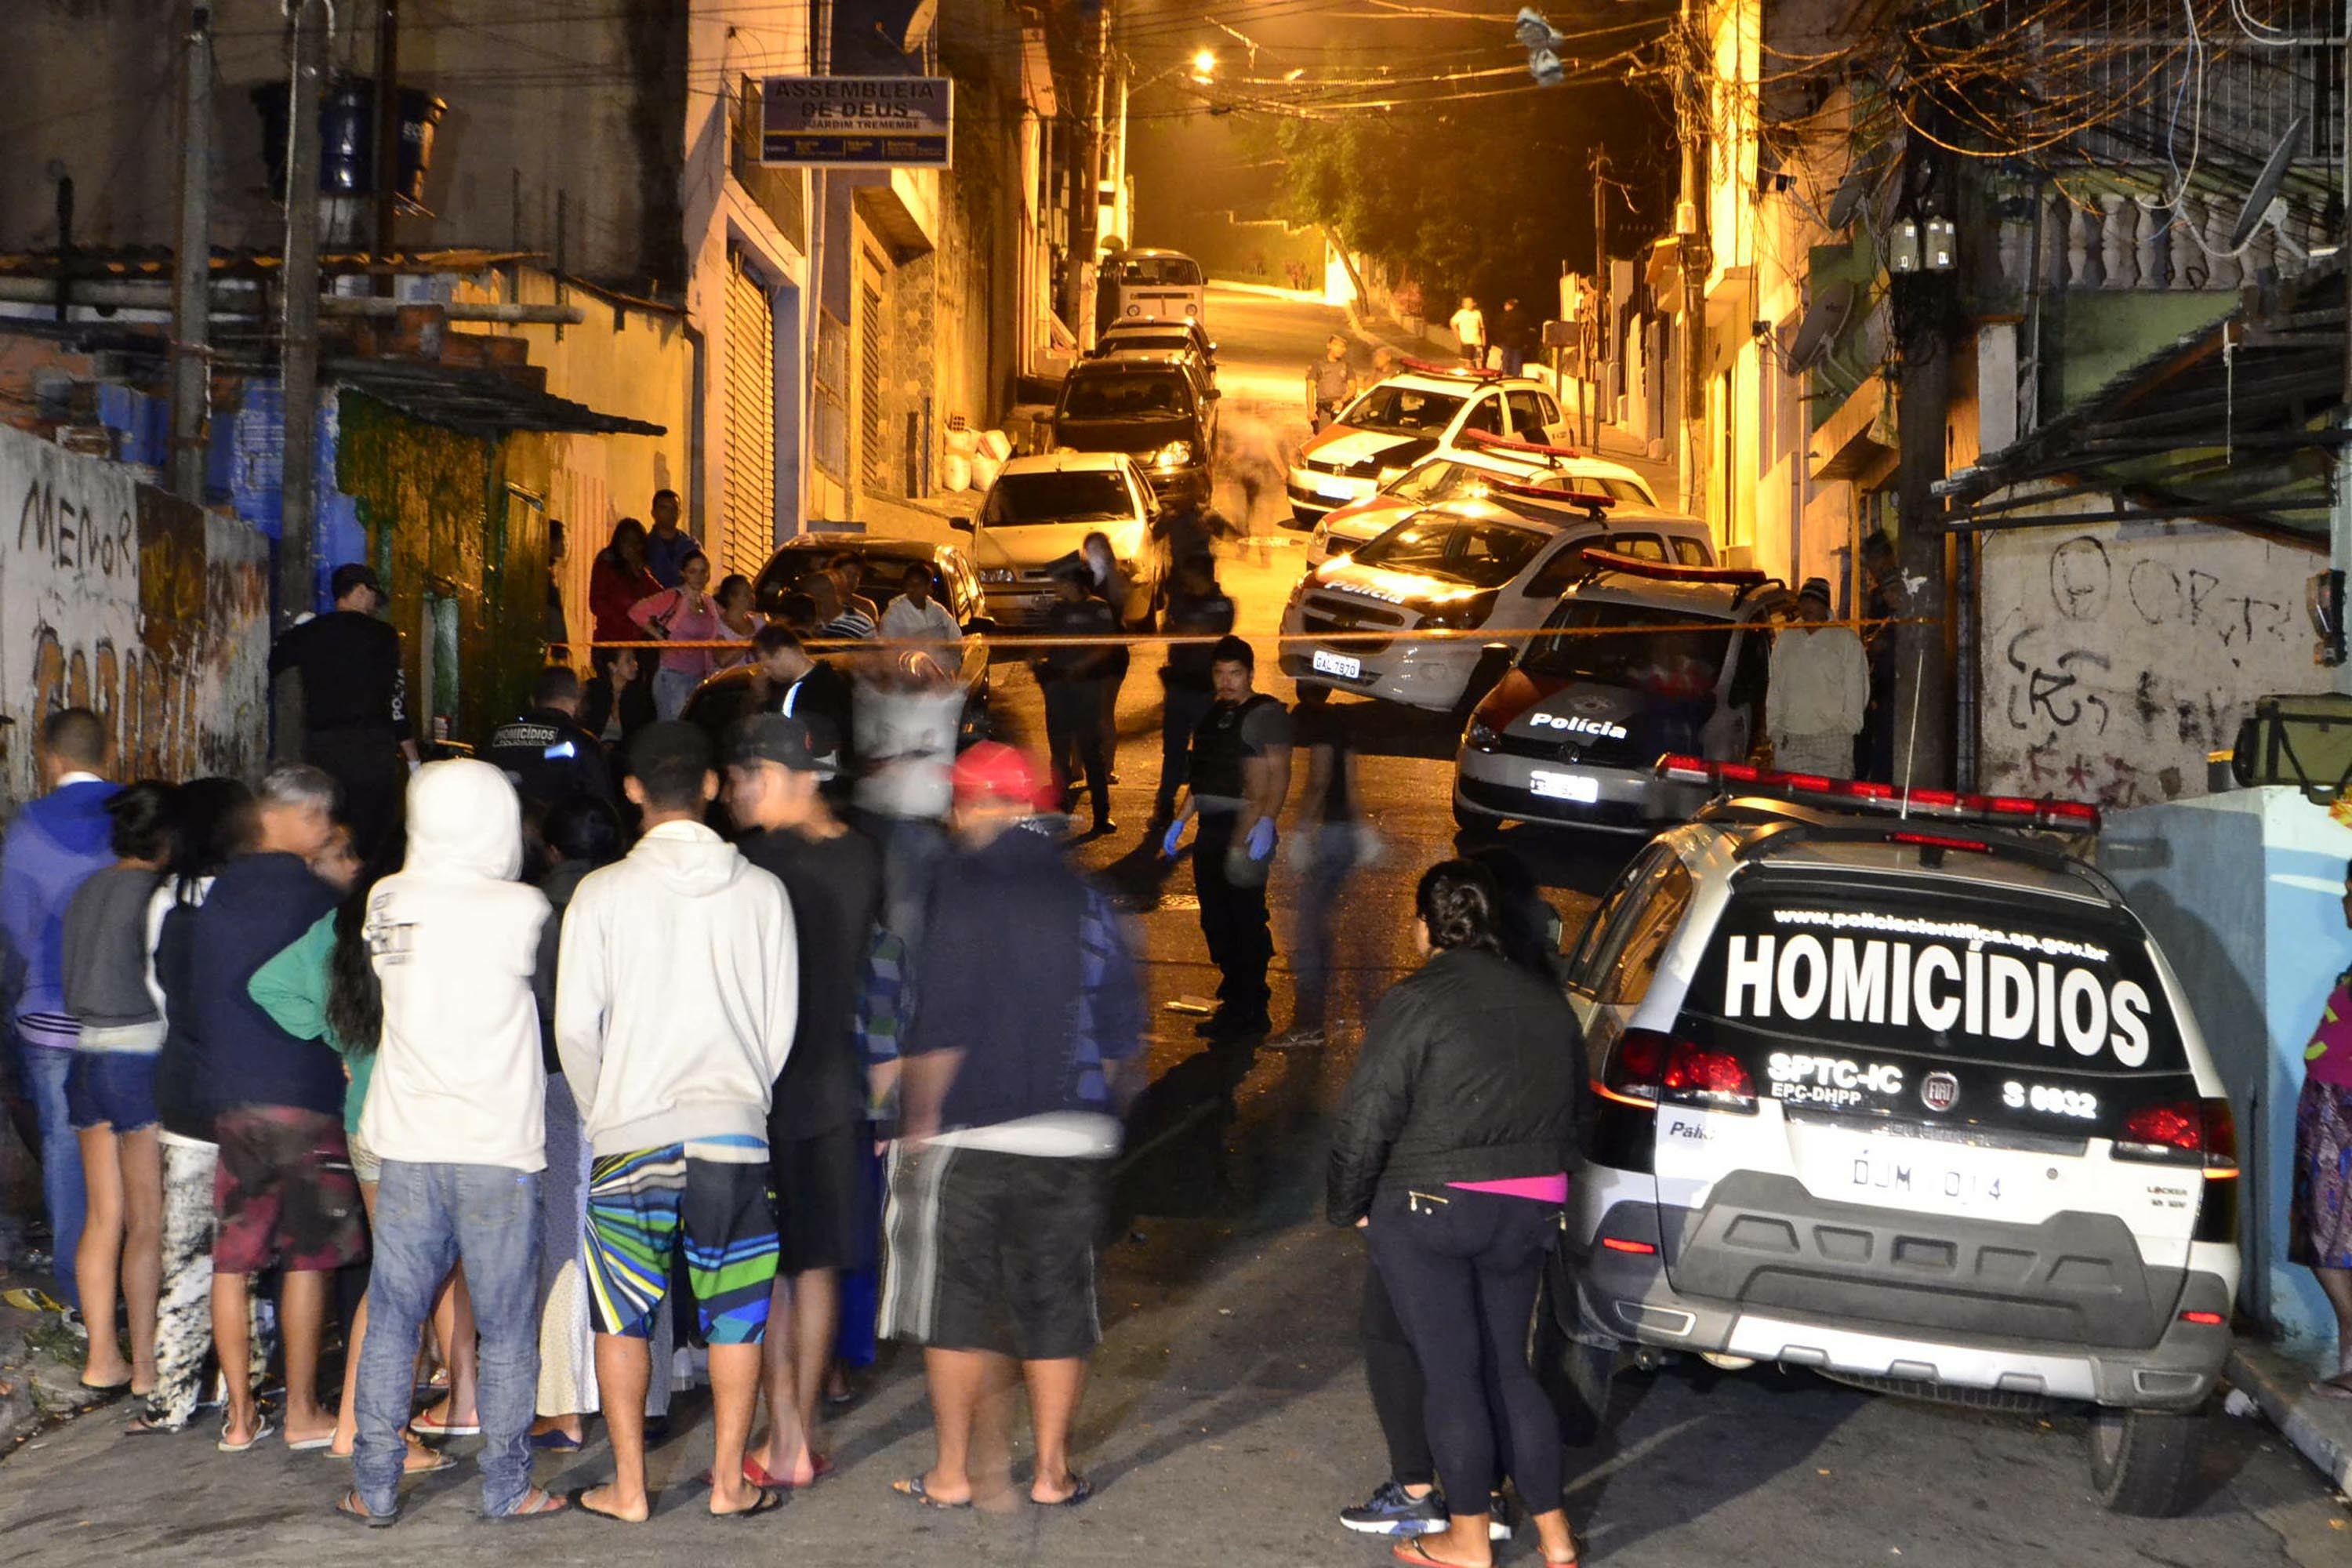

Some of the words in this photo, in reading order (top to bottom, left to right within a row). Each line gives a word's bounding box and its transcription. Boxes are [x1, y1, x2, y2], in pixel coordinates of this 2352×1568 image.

[775, 81, 935, 98] ASSEMBLEIA
[801, 102, 833, 118] DE
[841, 102, 909, 118] DEUS
[1530, 713, 1627, 739] Polícia
[1726, 934, 2151, 1068] HOMICÍDIOS
[1767, 1052, 1903, 1094] SPTC-IC
[1772, 1082, 1861, 1105] EPC-DHPP
[2003, 1081, 2025, 1107] S
